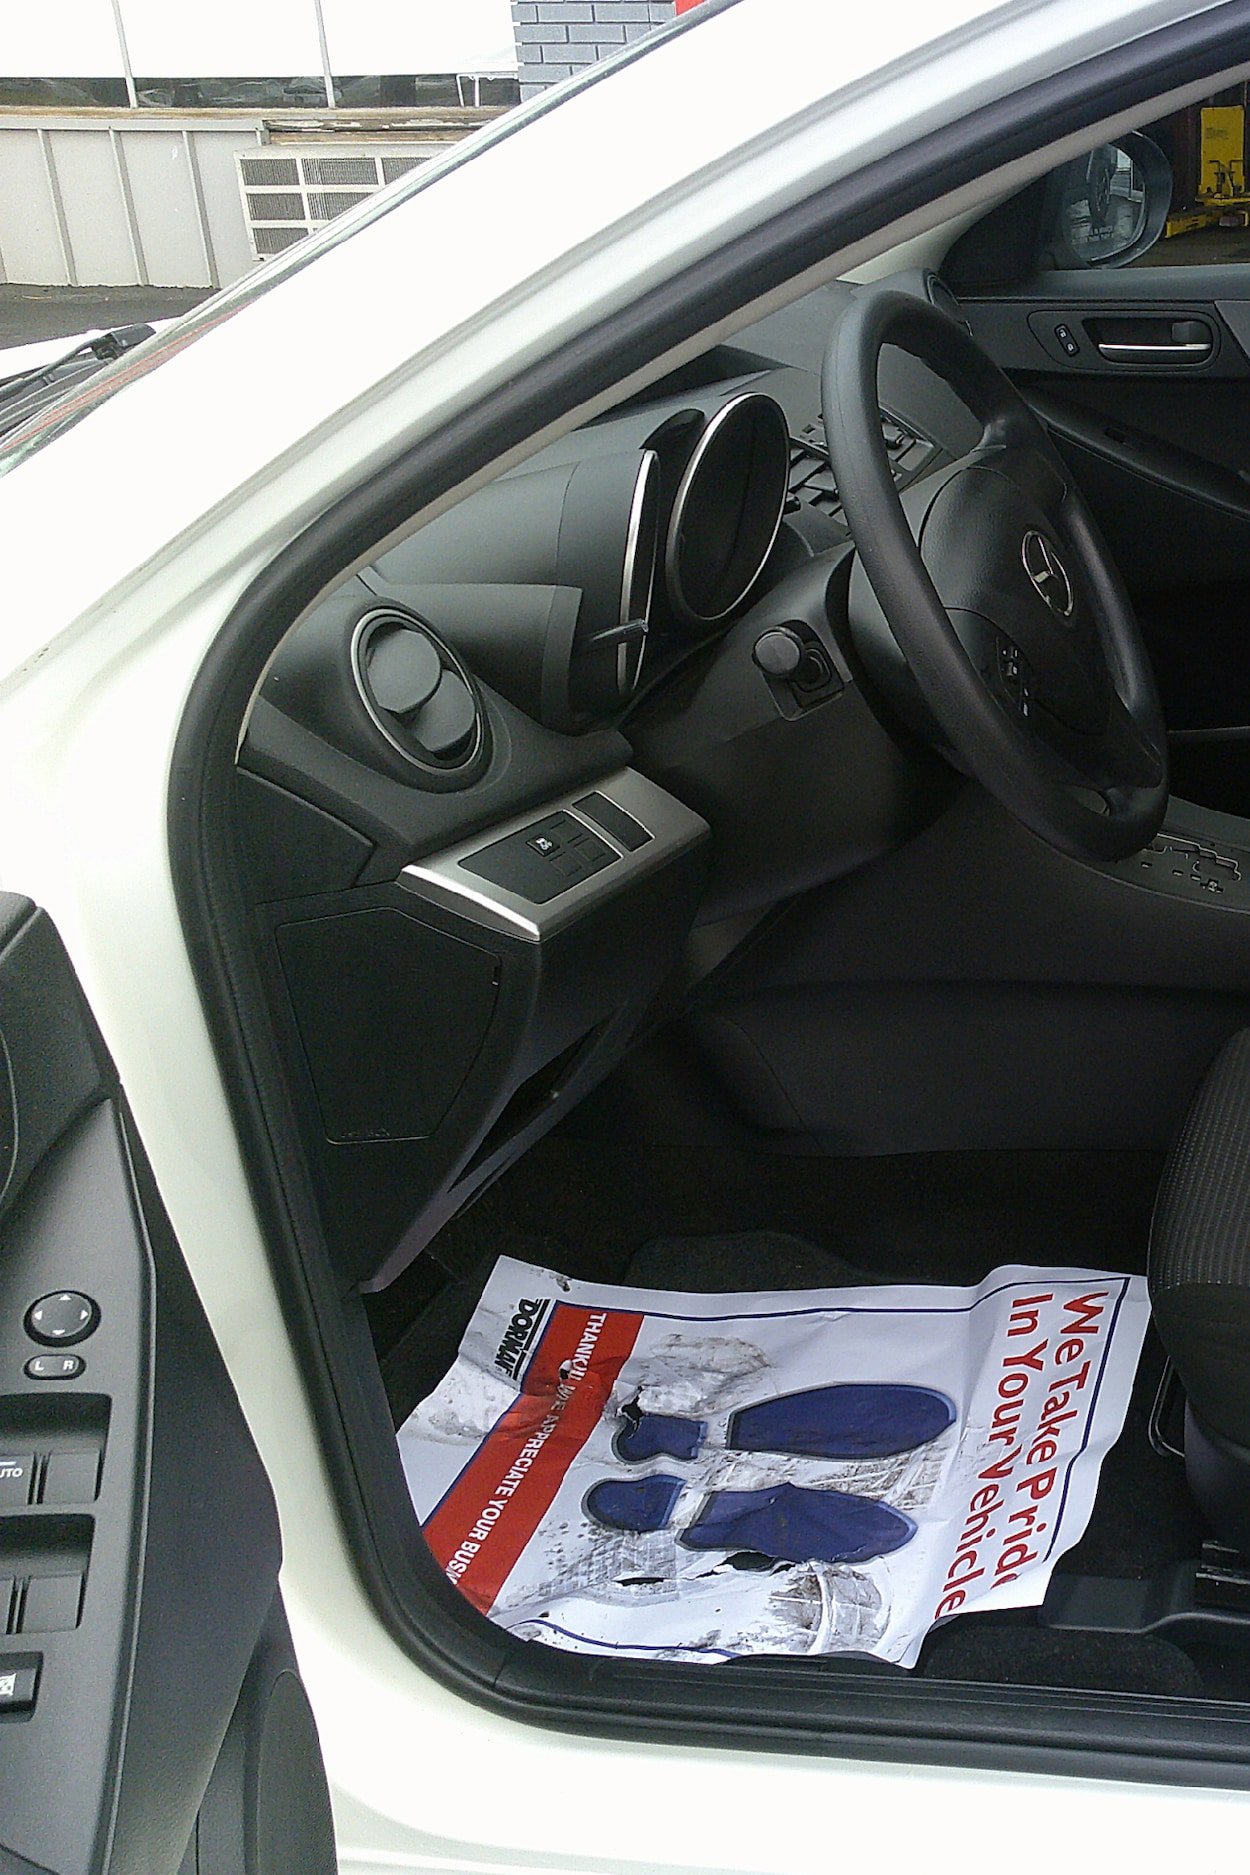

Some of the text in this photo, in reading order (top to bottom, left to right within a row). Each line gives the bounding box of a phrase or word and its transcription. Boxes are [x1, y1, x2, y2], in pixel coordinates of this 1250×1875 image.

[34, 1360, 74, 1371] L R
[494, 1299, 543, 1377] DORMAN
[1054, 1291, 1108, 1368] We
[1027, 1361, 1093, 1465] Take
[0, 1468, 23, 1478] UTO
[495, 1414, 560, 1497] APPRECIATE
[935, 1293, 1053, 1620] In Your Vehicle
[468, 1499, 508, 1541] YOUR
[445, 1541, 481, 1584] BUSIN
